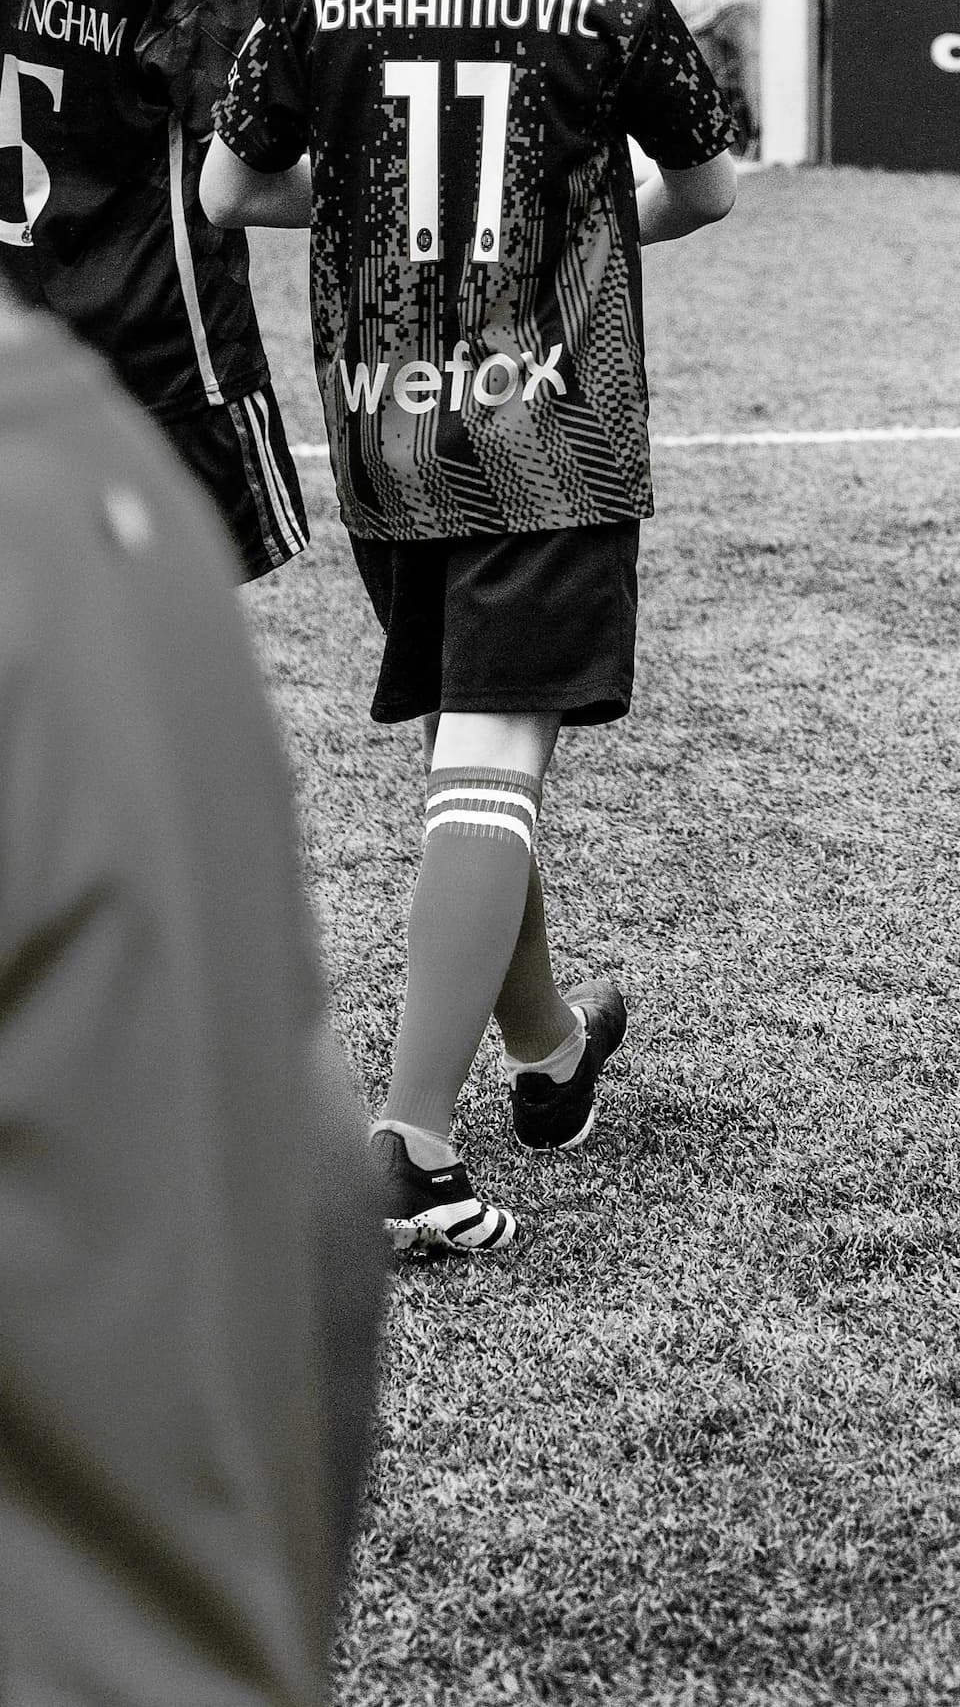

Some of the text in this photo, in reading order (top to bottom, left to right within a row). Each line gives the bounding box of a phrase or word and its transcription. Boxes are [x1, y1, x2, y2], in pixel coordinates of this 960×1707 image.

[0, 53, 64, 247] 5
[384, 61, 511, 262] 11
[339, 340, 568, 415] wefox
